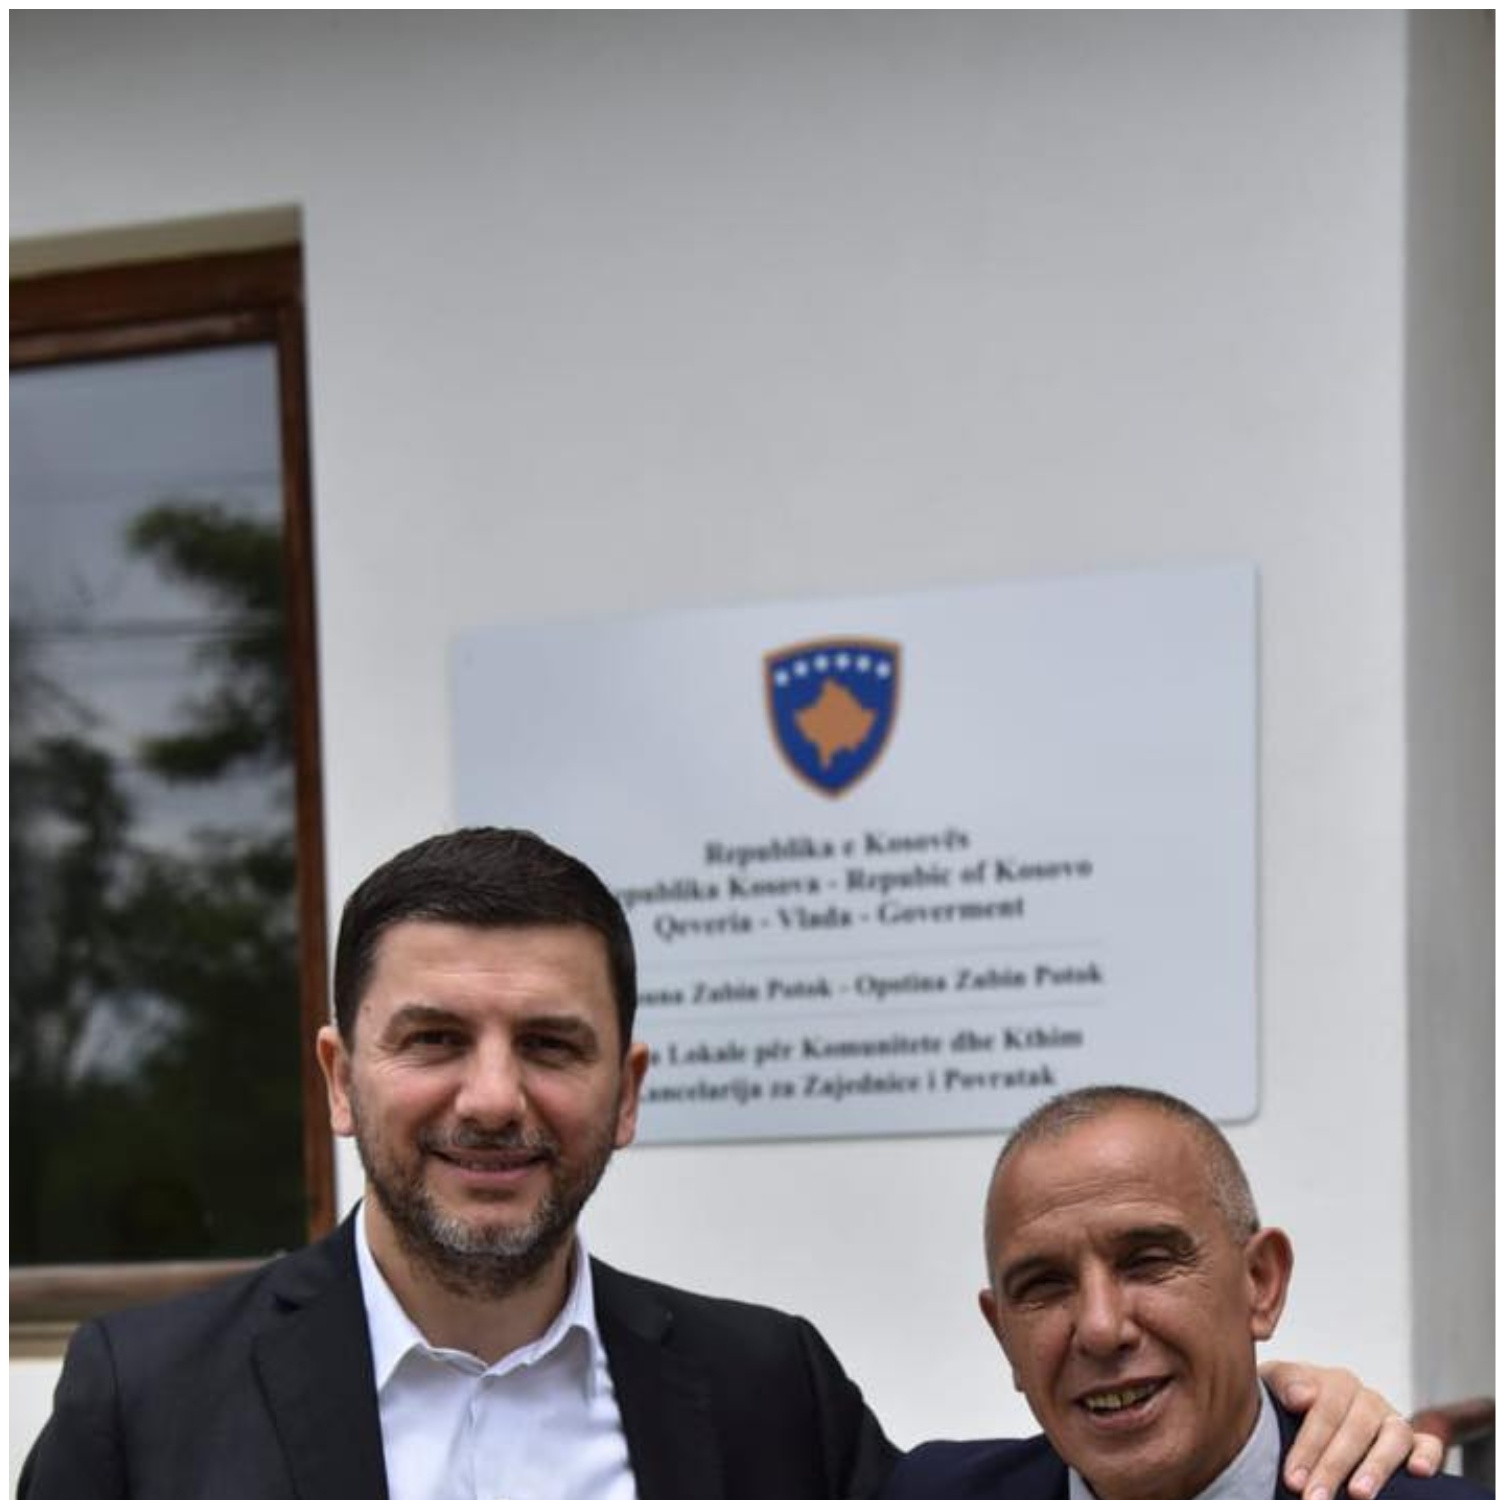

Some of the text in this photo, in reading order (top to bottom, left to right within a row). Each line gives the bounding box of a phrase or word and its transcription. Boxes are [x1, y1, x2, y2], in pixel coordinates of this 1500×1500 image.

[706, 838, 833, 867] Republika
[961, 860, 985, 883] of
[996, 858, 1093, 882] Kosovo
[777, 905, 852, 930] Vlada
[952, 1029, 993, 1052] dhe
[640, 1080, 761, 1105] ancelarija
